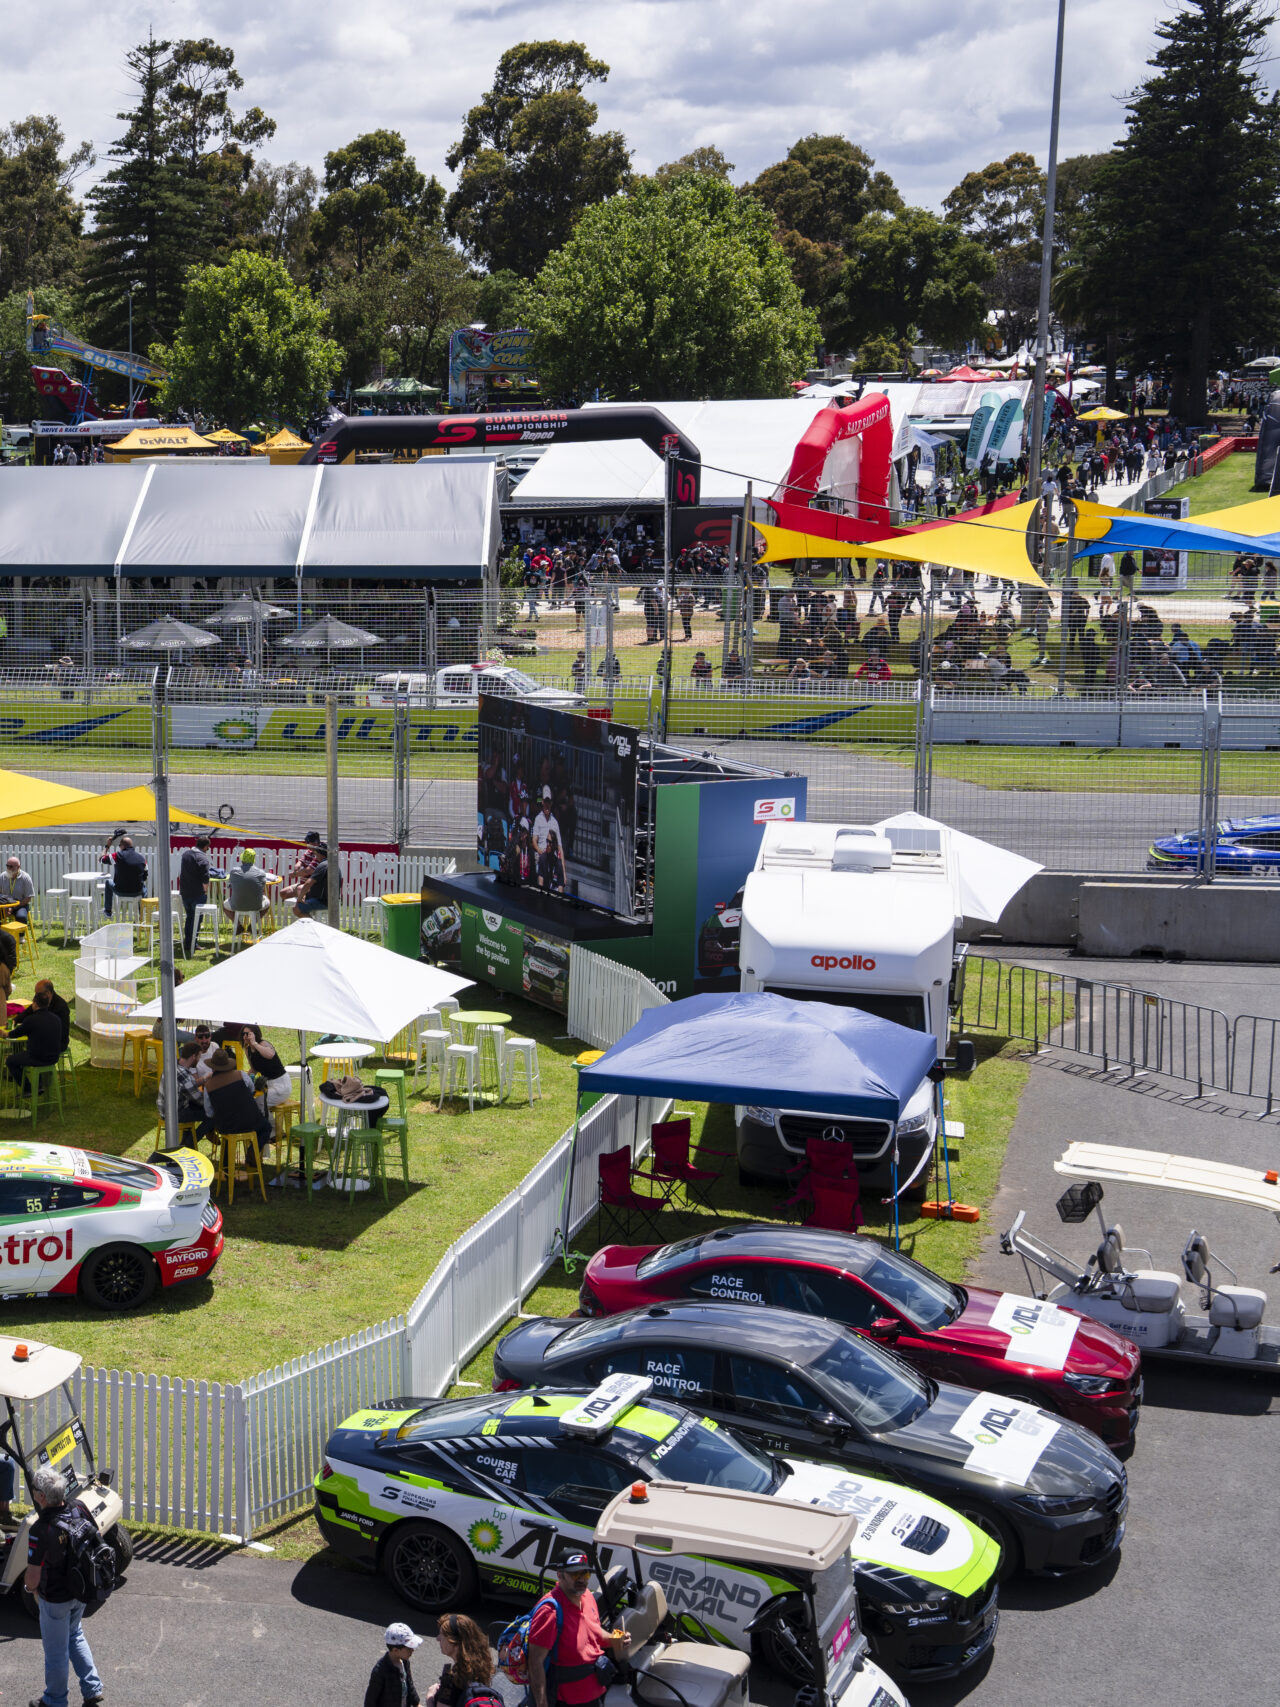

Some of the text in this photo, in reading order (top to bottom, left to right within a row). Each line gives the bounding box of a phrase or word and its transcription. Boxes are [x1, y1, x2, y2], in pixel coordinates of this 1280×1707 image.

[485, 414, 568, 423] SUPERCARS
[485, 421, 568, 431] CHAMPIONSHIP
[520, 431, 555, 441] Repco
[613, 735, 630, 747] ADL
[617, 744, 632, 758] GF
[479, 933, 507, 952] Welcome to
[491, 950, 510, 966] pavilion
[811, 954, 876, 971] apollo
[26, 1198, 43, 1213] 55
[120, 1193, 140, 1203] dba
[166, 1250, 208, 1264] BAYFORD
[174, 1266, 199, 1275] FORD
[710, 1274, 744, 1289] RACE
[710, 1287, 766, 1305] CONTROL
[1012, 1305, 1043, 1330] ADL
[647, 1360, 680, 1375] RACE
[605, 1374, 632, 1393] GRAND
[614, 1379, 639, 1397] FINAL
[583, 1395, 621, 1419] ADL
[979, 1408, 1044, 1438] ADL GF
[767, 1439, 791, 1450] THE
[476, 1455, 518, 1471] COURSE
[495, 1467, 516, 1480] CAR
[403, 1490, 437, 1505] SUPERCARS
[341, 1511, 374, 1527] JARVIS FORD
[492, 1507, 507, 1521] bp
[492, 1575, 519, 1588] 27-30
[648, 1561, 761, 1609] GRAND
